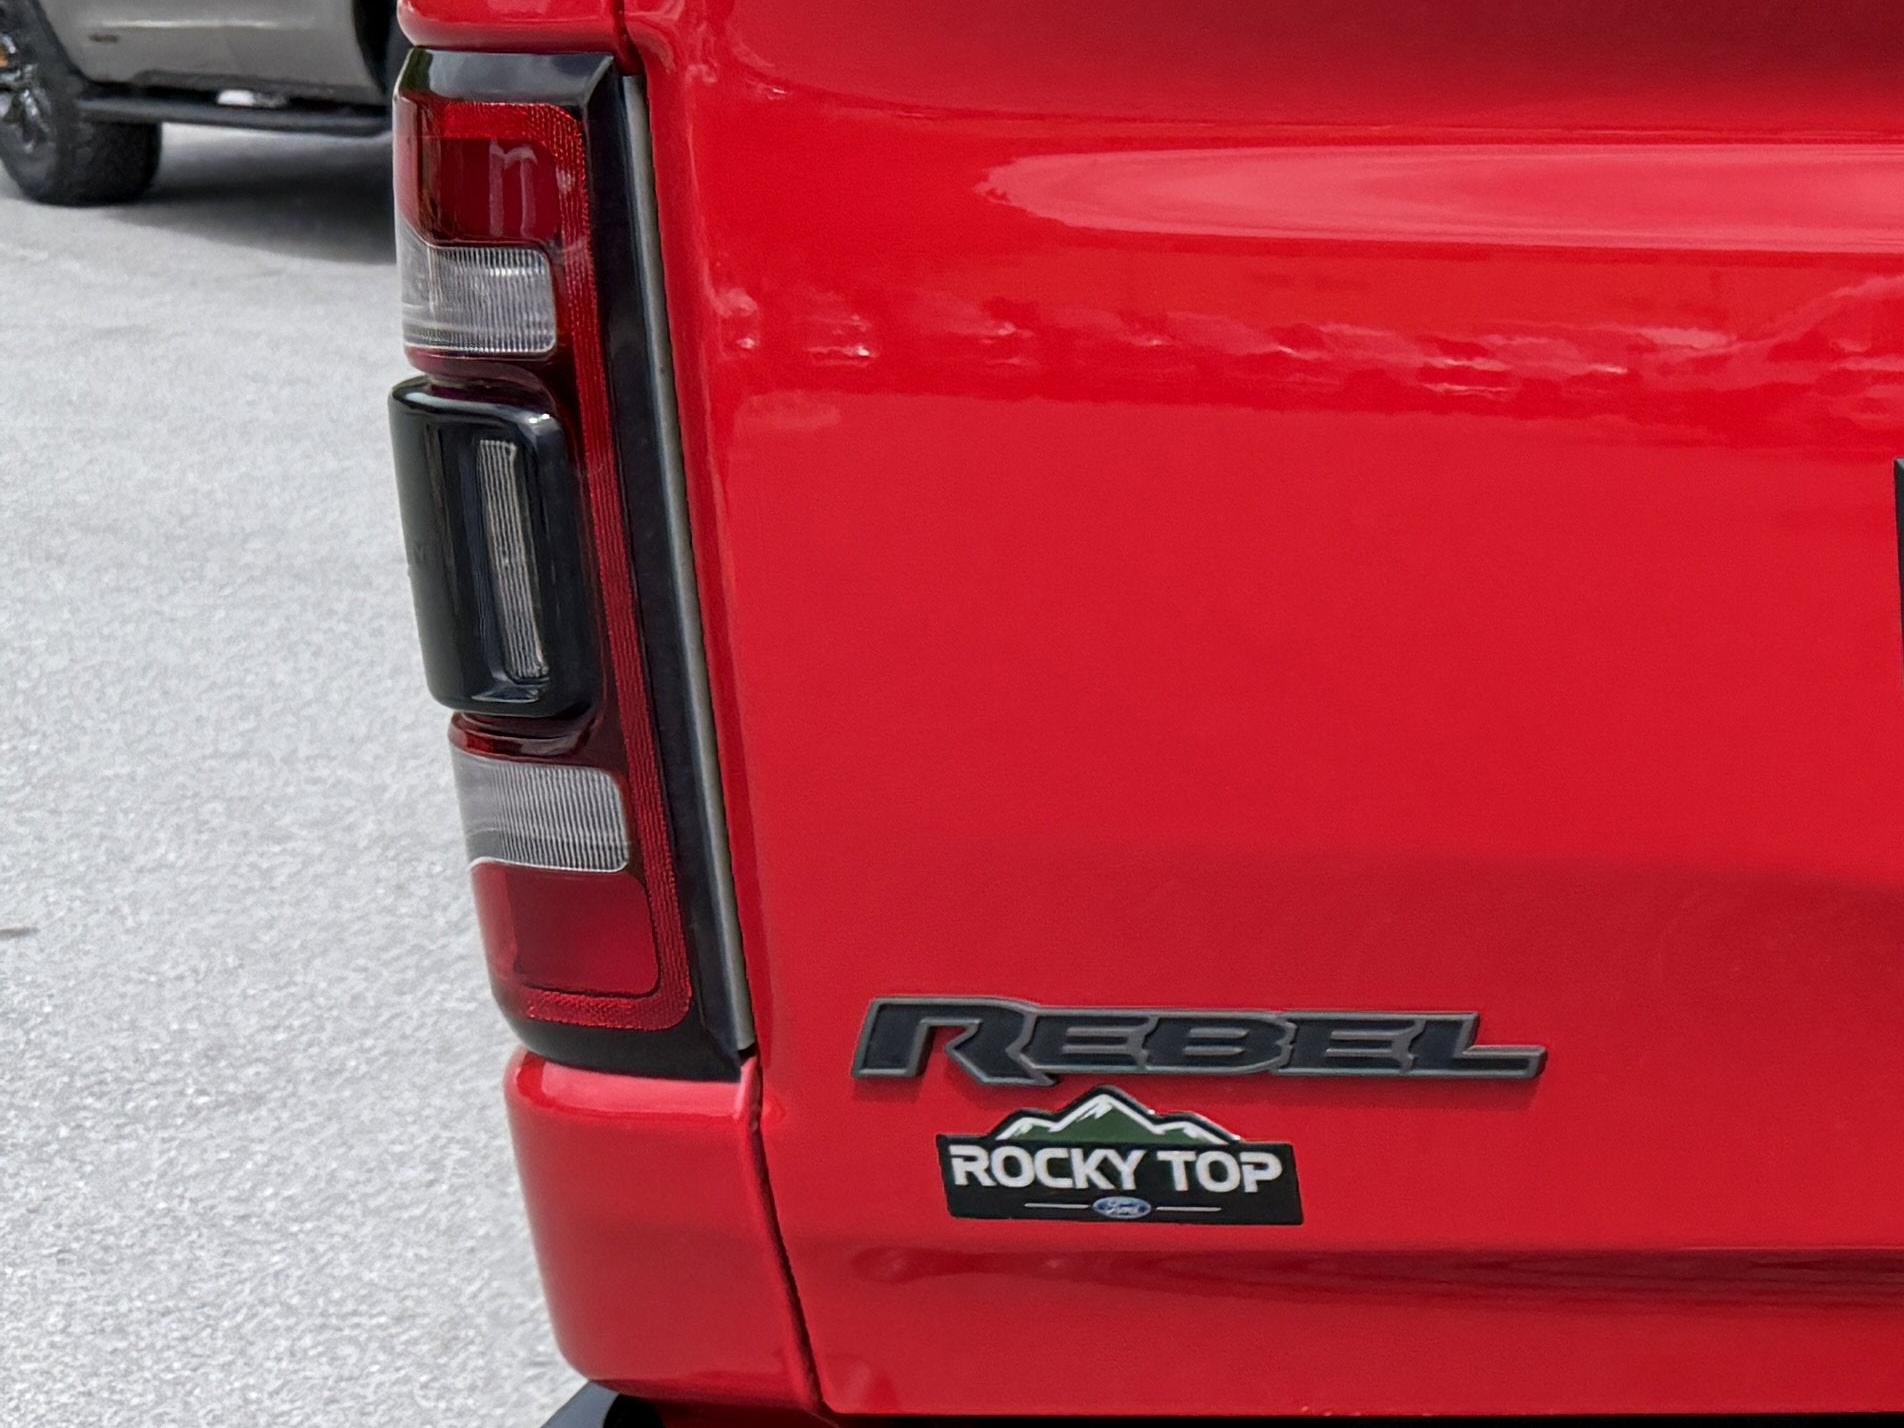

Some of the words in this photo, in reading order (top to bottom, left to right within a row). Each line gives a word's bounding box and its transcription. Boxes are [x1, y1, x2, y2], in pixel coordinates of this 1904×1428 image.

[850, 996, 1547, 1087] REBEL
[947, 1144, 1147, 1192] ROCKY
[1156, 1149, 1283, 1195] TOP
